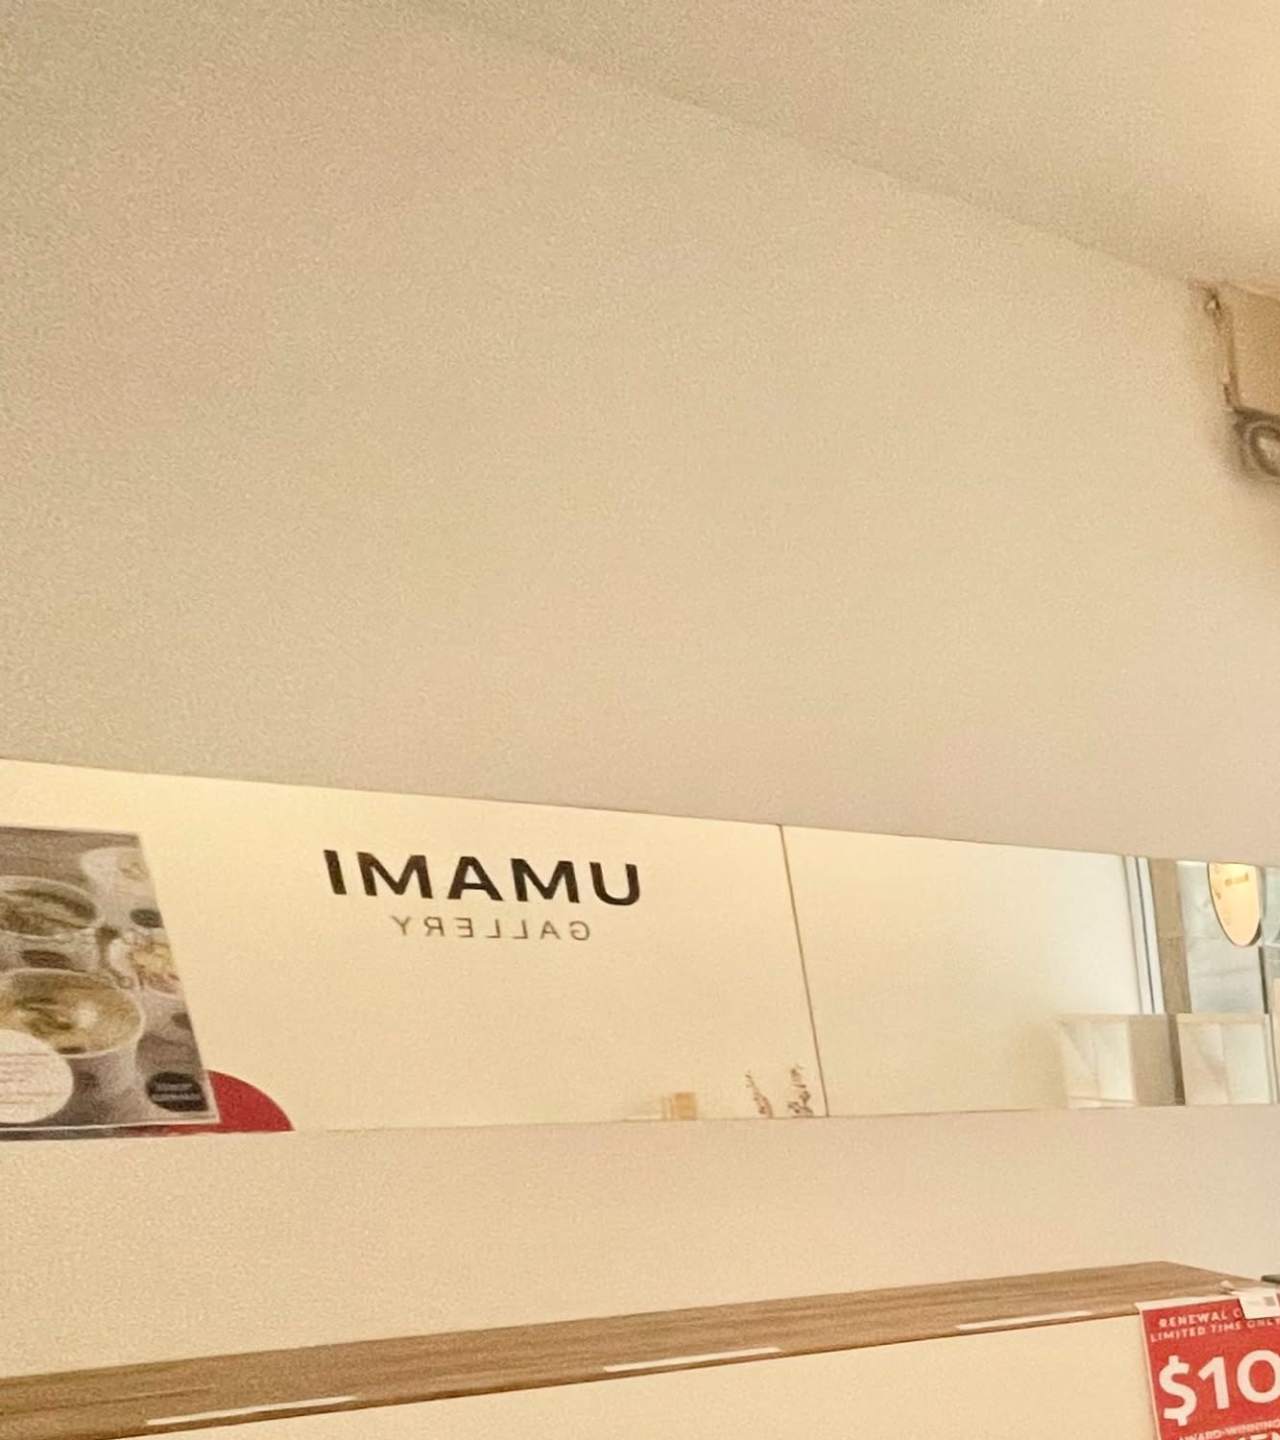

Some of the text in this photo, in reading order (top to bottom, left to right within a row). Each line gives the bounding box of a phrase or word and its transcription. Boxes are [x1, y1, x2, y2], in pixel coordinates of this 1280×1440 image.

[1158, 1310, 1228, 1329] RENEWAL
[1150, 1325, 1206, 1343] LIMITED
[1211, 1321, 1243, 1334] TIME
